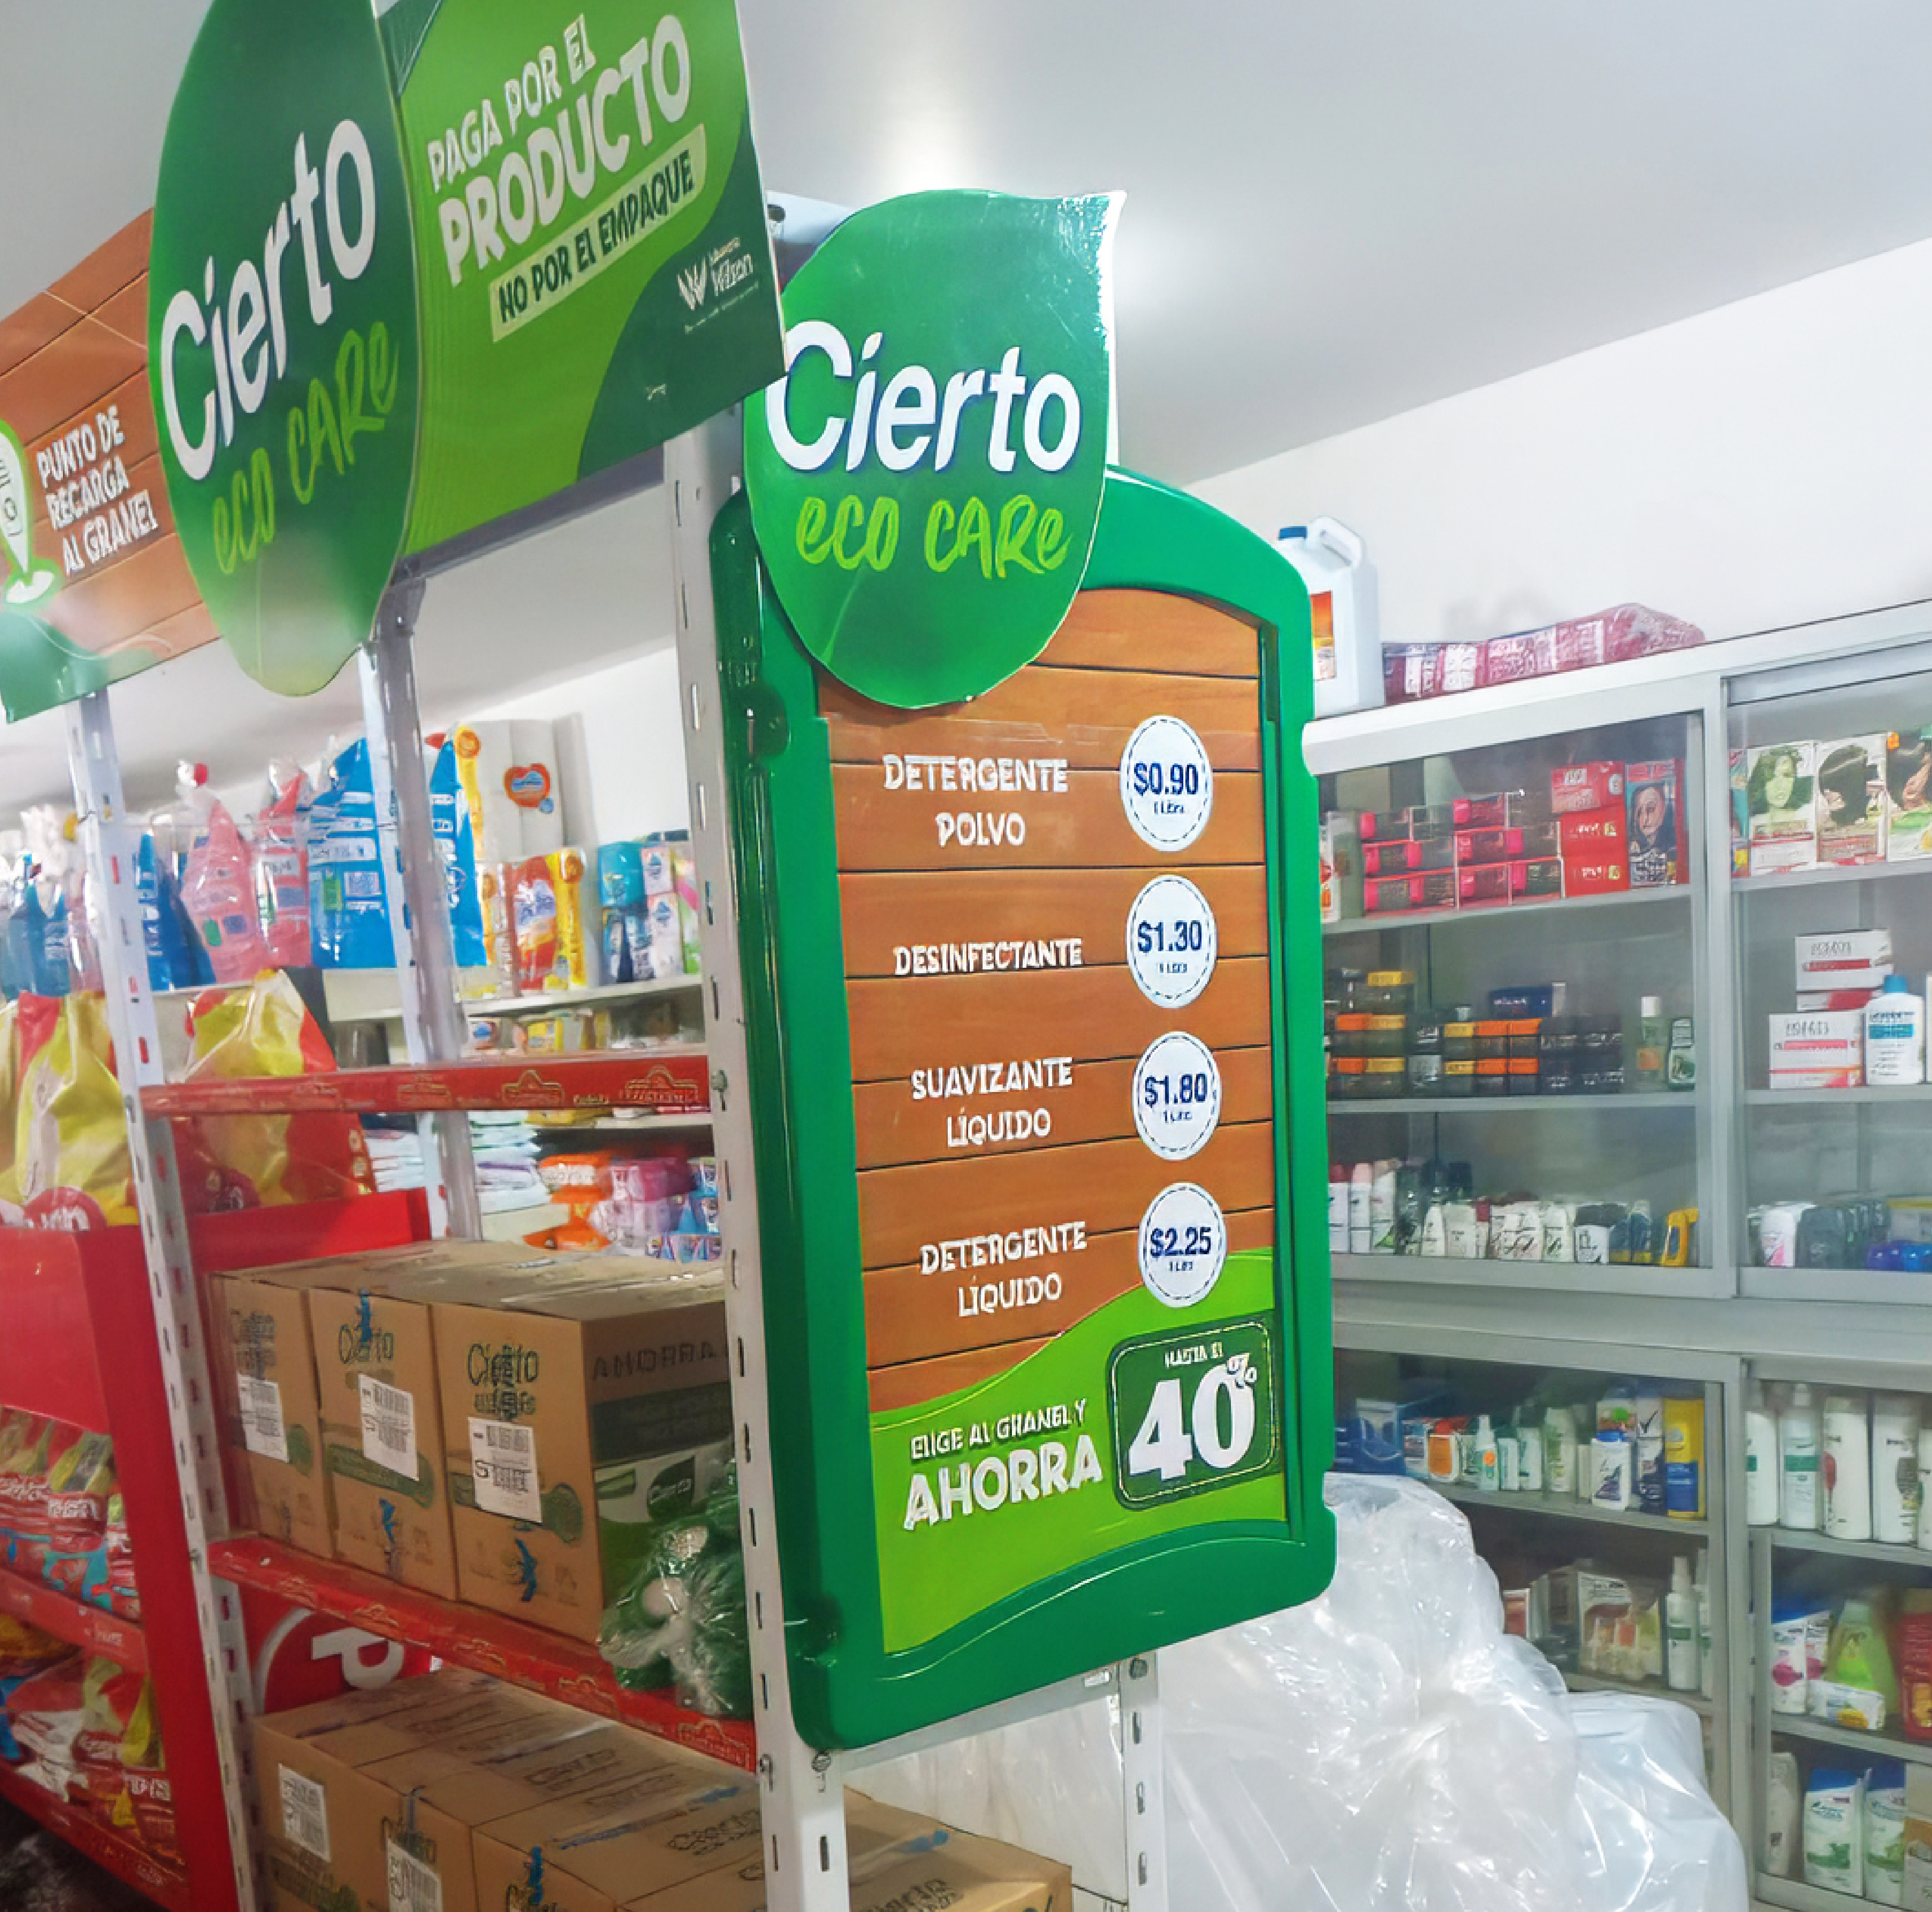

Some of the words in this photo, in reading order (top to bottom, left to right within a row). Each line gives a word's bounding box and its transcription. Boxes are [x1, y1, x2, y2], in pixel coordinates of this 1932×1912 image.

[427, 99, 502, 192] PAGA
[503, 45, 562, 135] POR
[438, 14, 691, 287] PRODUCTO
[498, 275, 529, 323] NO
[531, 246, 572, 302] POR
[598, 149, 695, 256] EMPAQUE
[161, 119, 377, 480] Cierto
[765, 320, 1081, 473] Cierto
[36, 426, 96, 488] PUNTO
[97, 405, 125, 448] DE
[45, 456, 130, 529] RECARGA
[882, 754, 1068, 794] DETERGENTE
[1133, 762, 1199, 796] $0.90
[935, 812, 1026, 847] POLVO
[893, 937, 1082, 976] DESINFECTANTE
[1137, 920, 1202, 954] $1.30
[910, 1056, 1073, 1100] SUAVIZANTE
[1144, 1072, 1207, 1108] $1.80
[946, 1106, 1051, 1148] LÍQUIDO
[919, 1221, 1087, 1276] DETERGENTE
[1150, 1227, 1212, 1260] $2.25
[958, 1274, 1062, 1318] LÍQUIDO
[995, 1405, 1071, 1441] GRANEL
[1073, 1397, 1088, 1427] Y
[902, 1433, 1103, 1531] AHORRA
